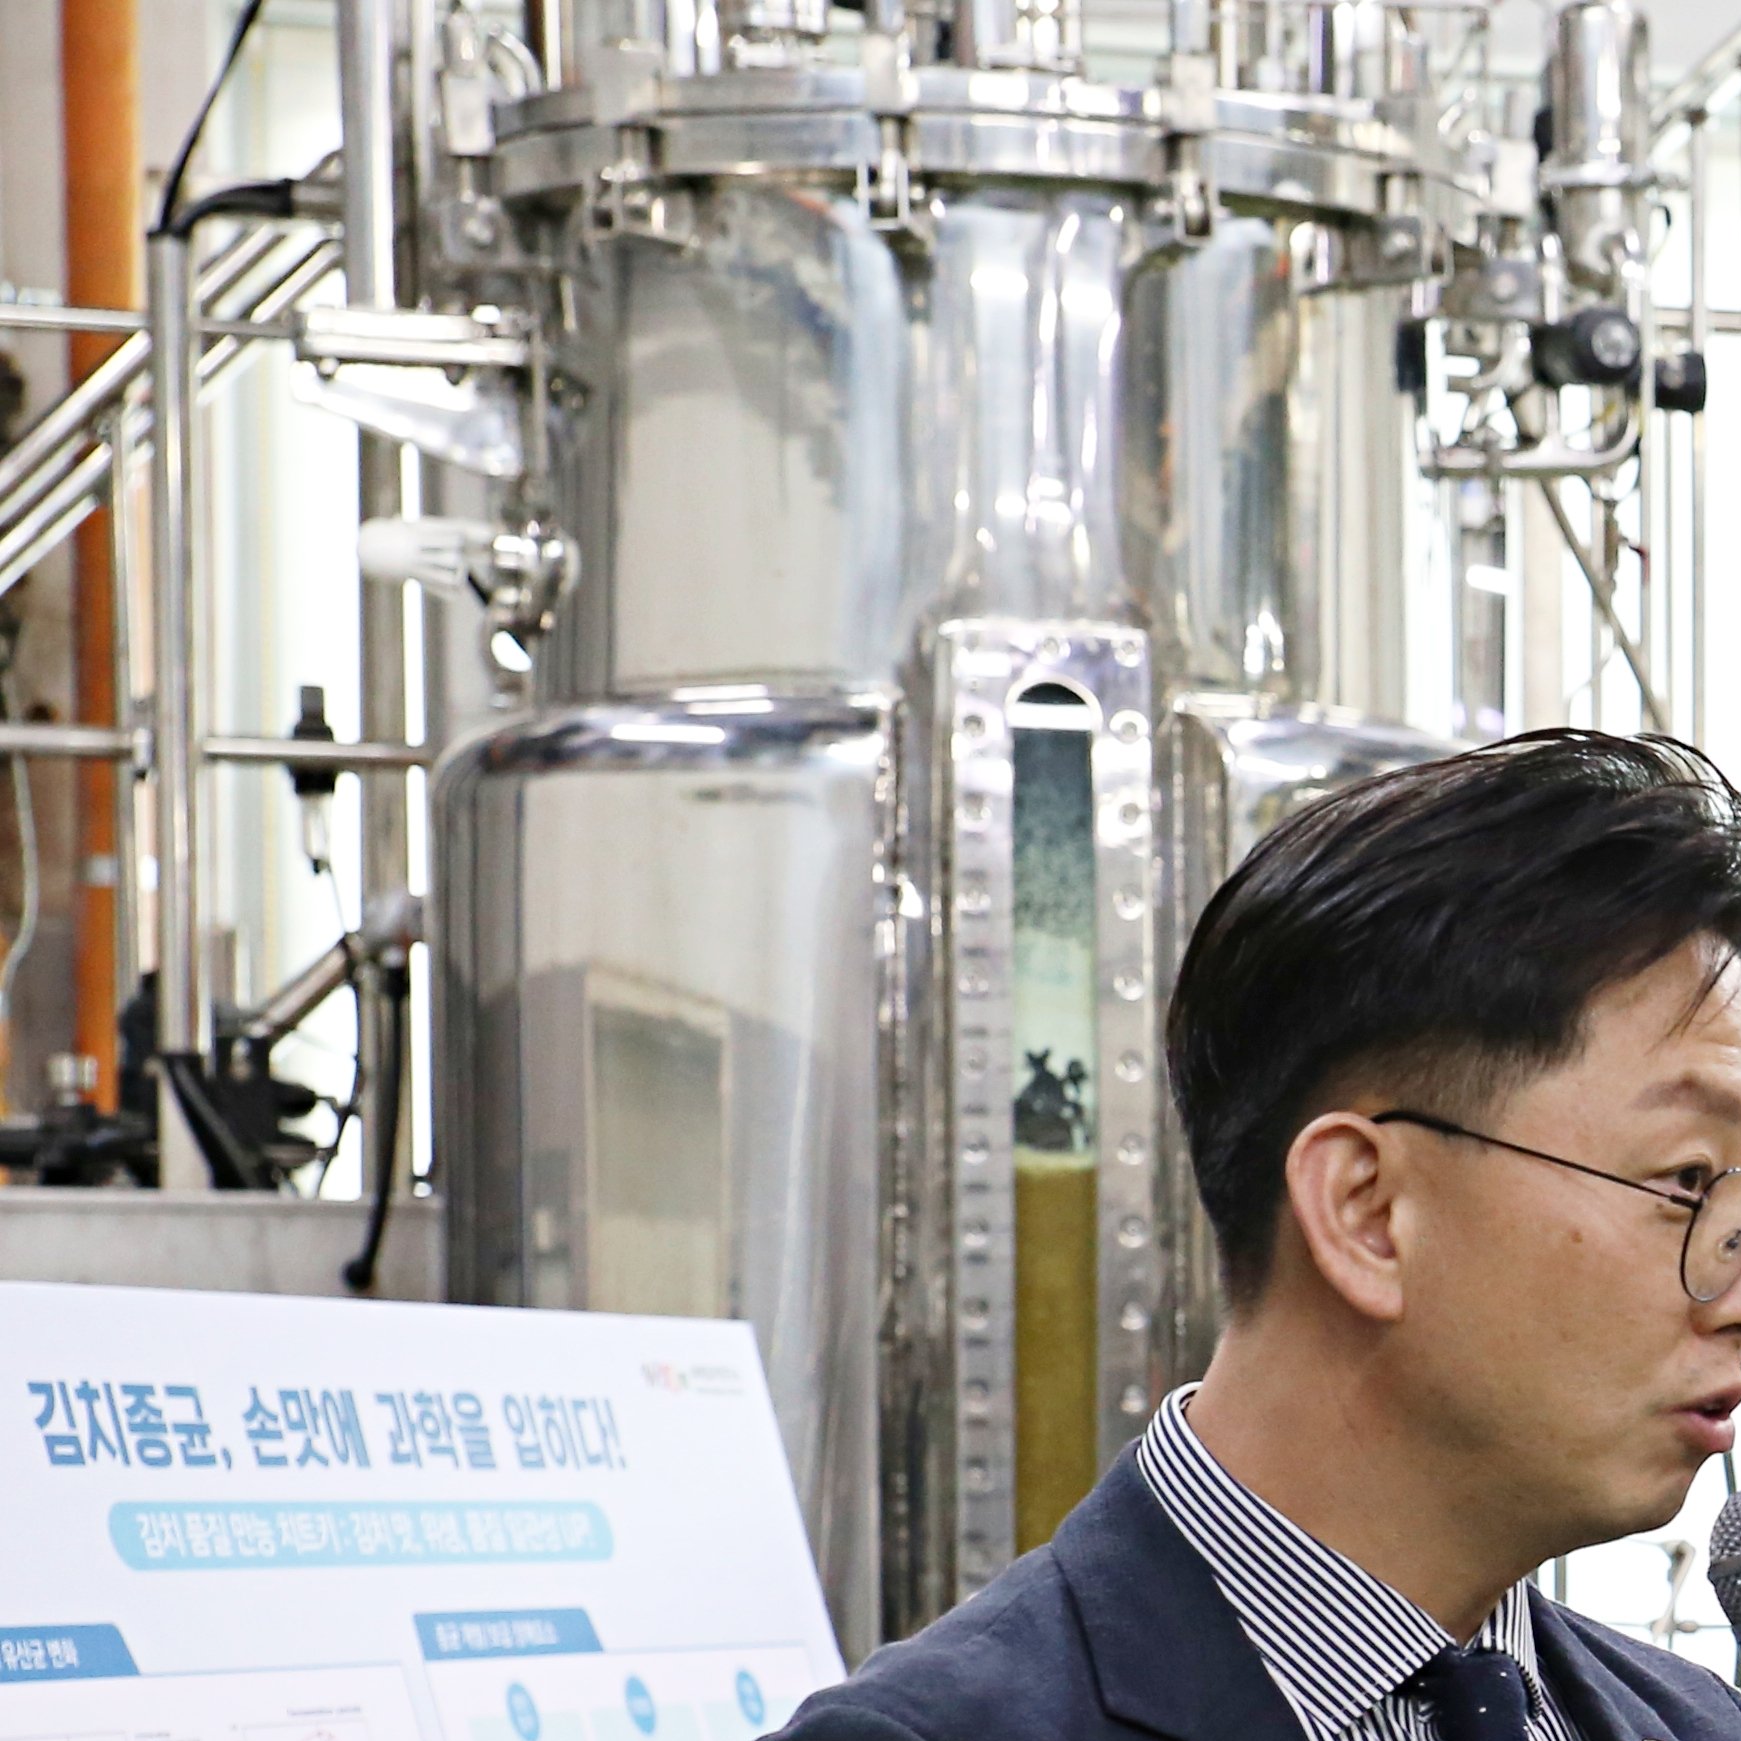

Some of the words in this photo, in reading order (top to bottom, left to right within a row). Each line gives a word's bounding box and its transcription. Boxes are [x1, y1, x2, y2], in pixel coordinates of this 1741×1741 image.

[27, 1380, 233, 1470] 김치종균,
[242, 1386, 371, 1468] 손맛에
[374, 1391, 498, 1468] 과학을
[503, 1394, 627, 1470] 입히다!
[136, 1511, 188, 1558] 김치
